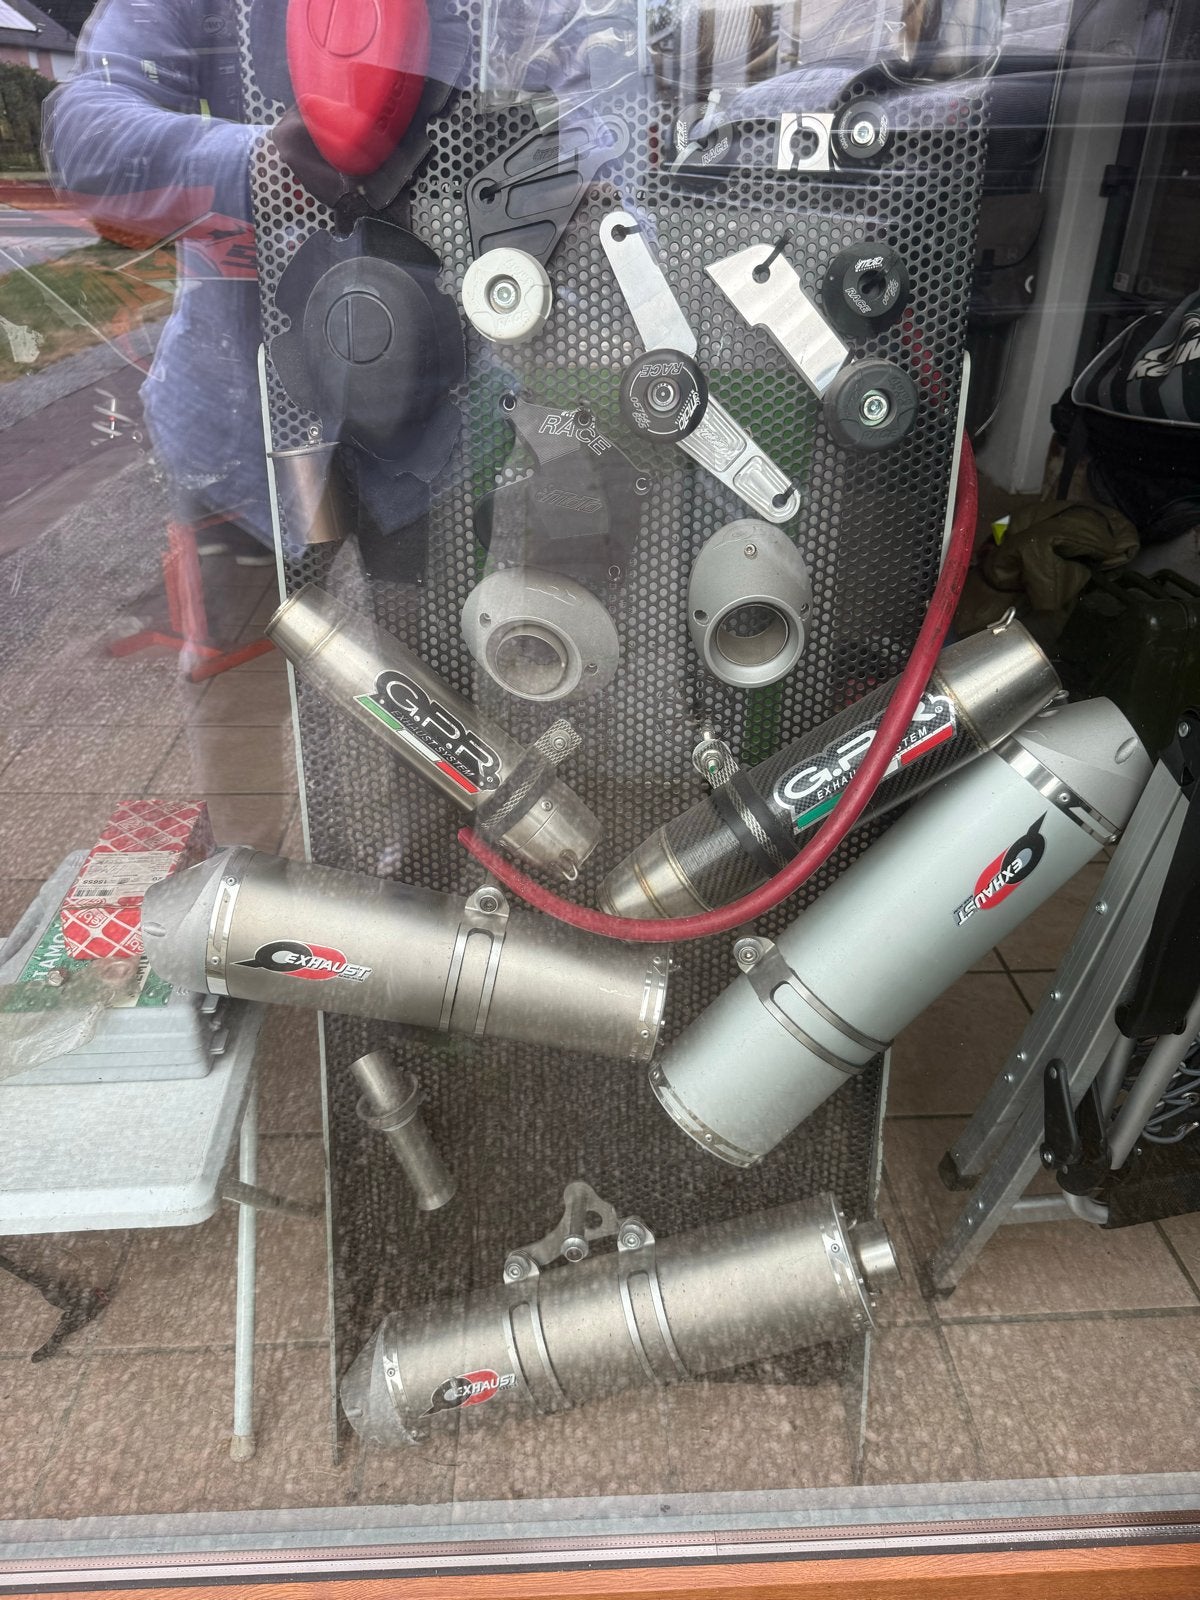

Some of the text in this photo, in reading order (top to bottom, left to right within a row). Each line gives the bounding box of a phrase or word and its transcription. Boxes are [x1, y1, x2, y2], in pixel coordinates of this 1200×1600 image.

[701, 137, 728, 167] RACE
[844, 287, 871, 313] RACE
[640, 362, 684, 378] RACE
[538, 414, 612, 456] RACE
[391, 710, 476, 777] EXHAUST SYSTEM
[959, 857, 1023, 925] EXHAUST
[285, 953, 372, 979] EXHAUST
[454, 1373, 516, 1397] EXHAUST
